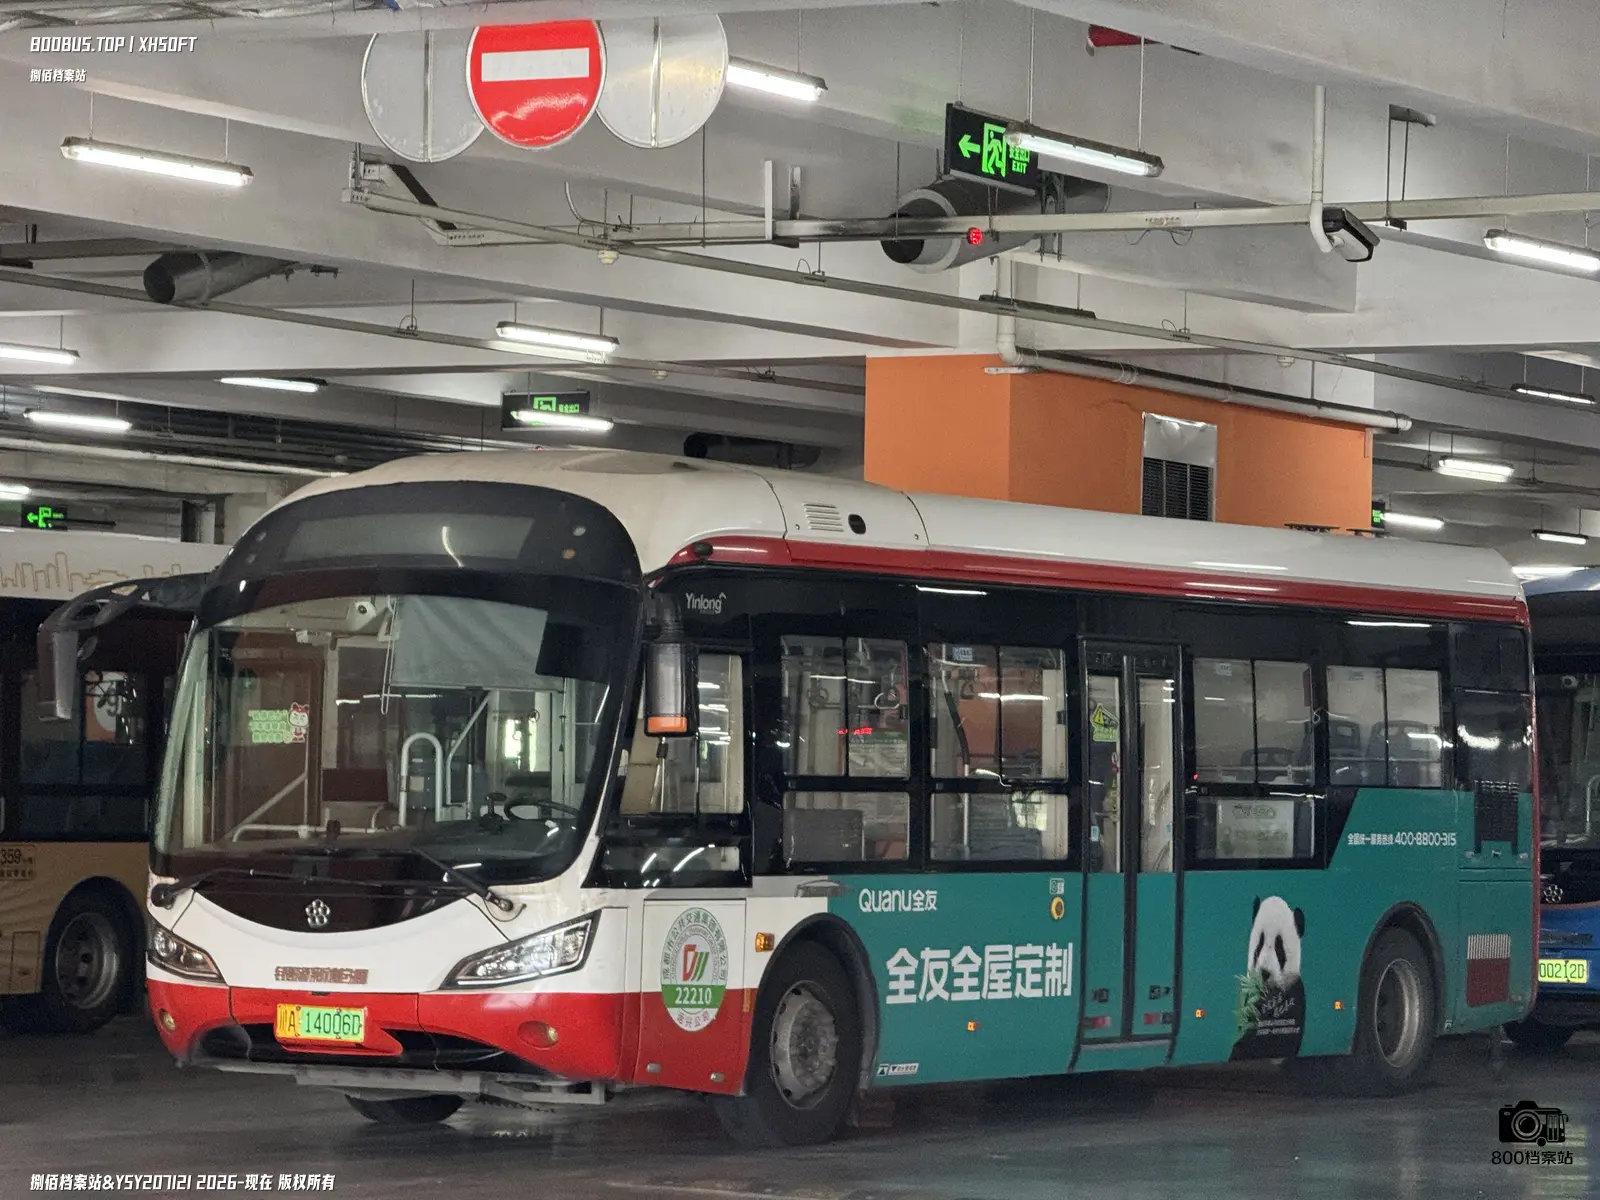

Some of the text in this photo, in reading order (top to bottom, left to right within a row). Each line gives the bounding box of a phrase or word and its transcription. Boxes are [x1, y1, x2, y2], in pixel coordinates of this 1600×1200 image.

[1012, 160, 1028, 174] EXIT
[685, 592, 722, 614] Yinlong
[1395, 831, 1457, 846] 400-8800-315
[885, 942, 1074, 1005] 全友全屋定制
[674, 986, 713, 1005] 22210
